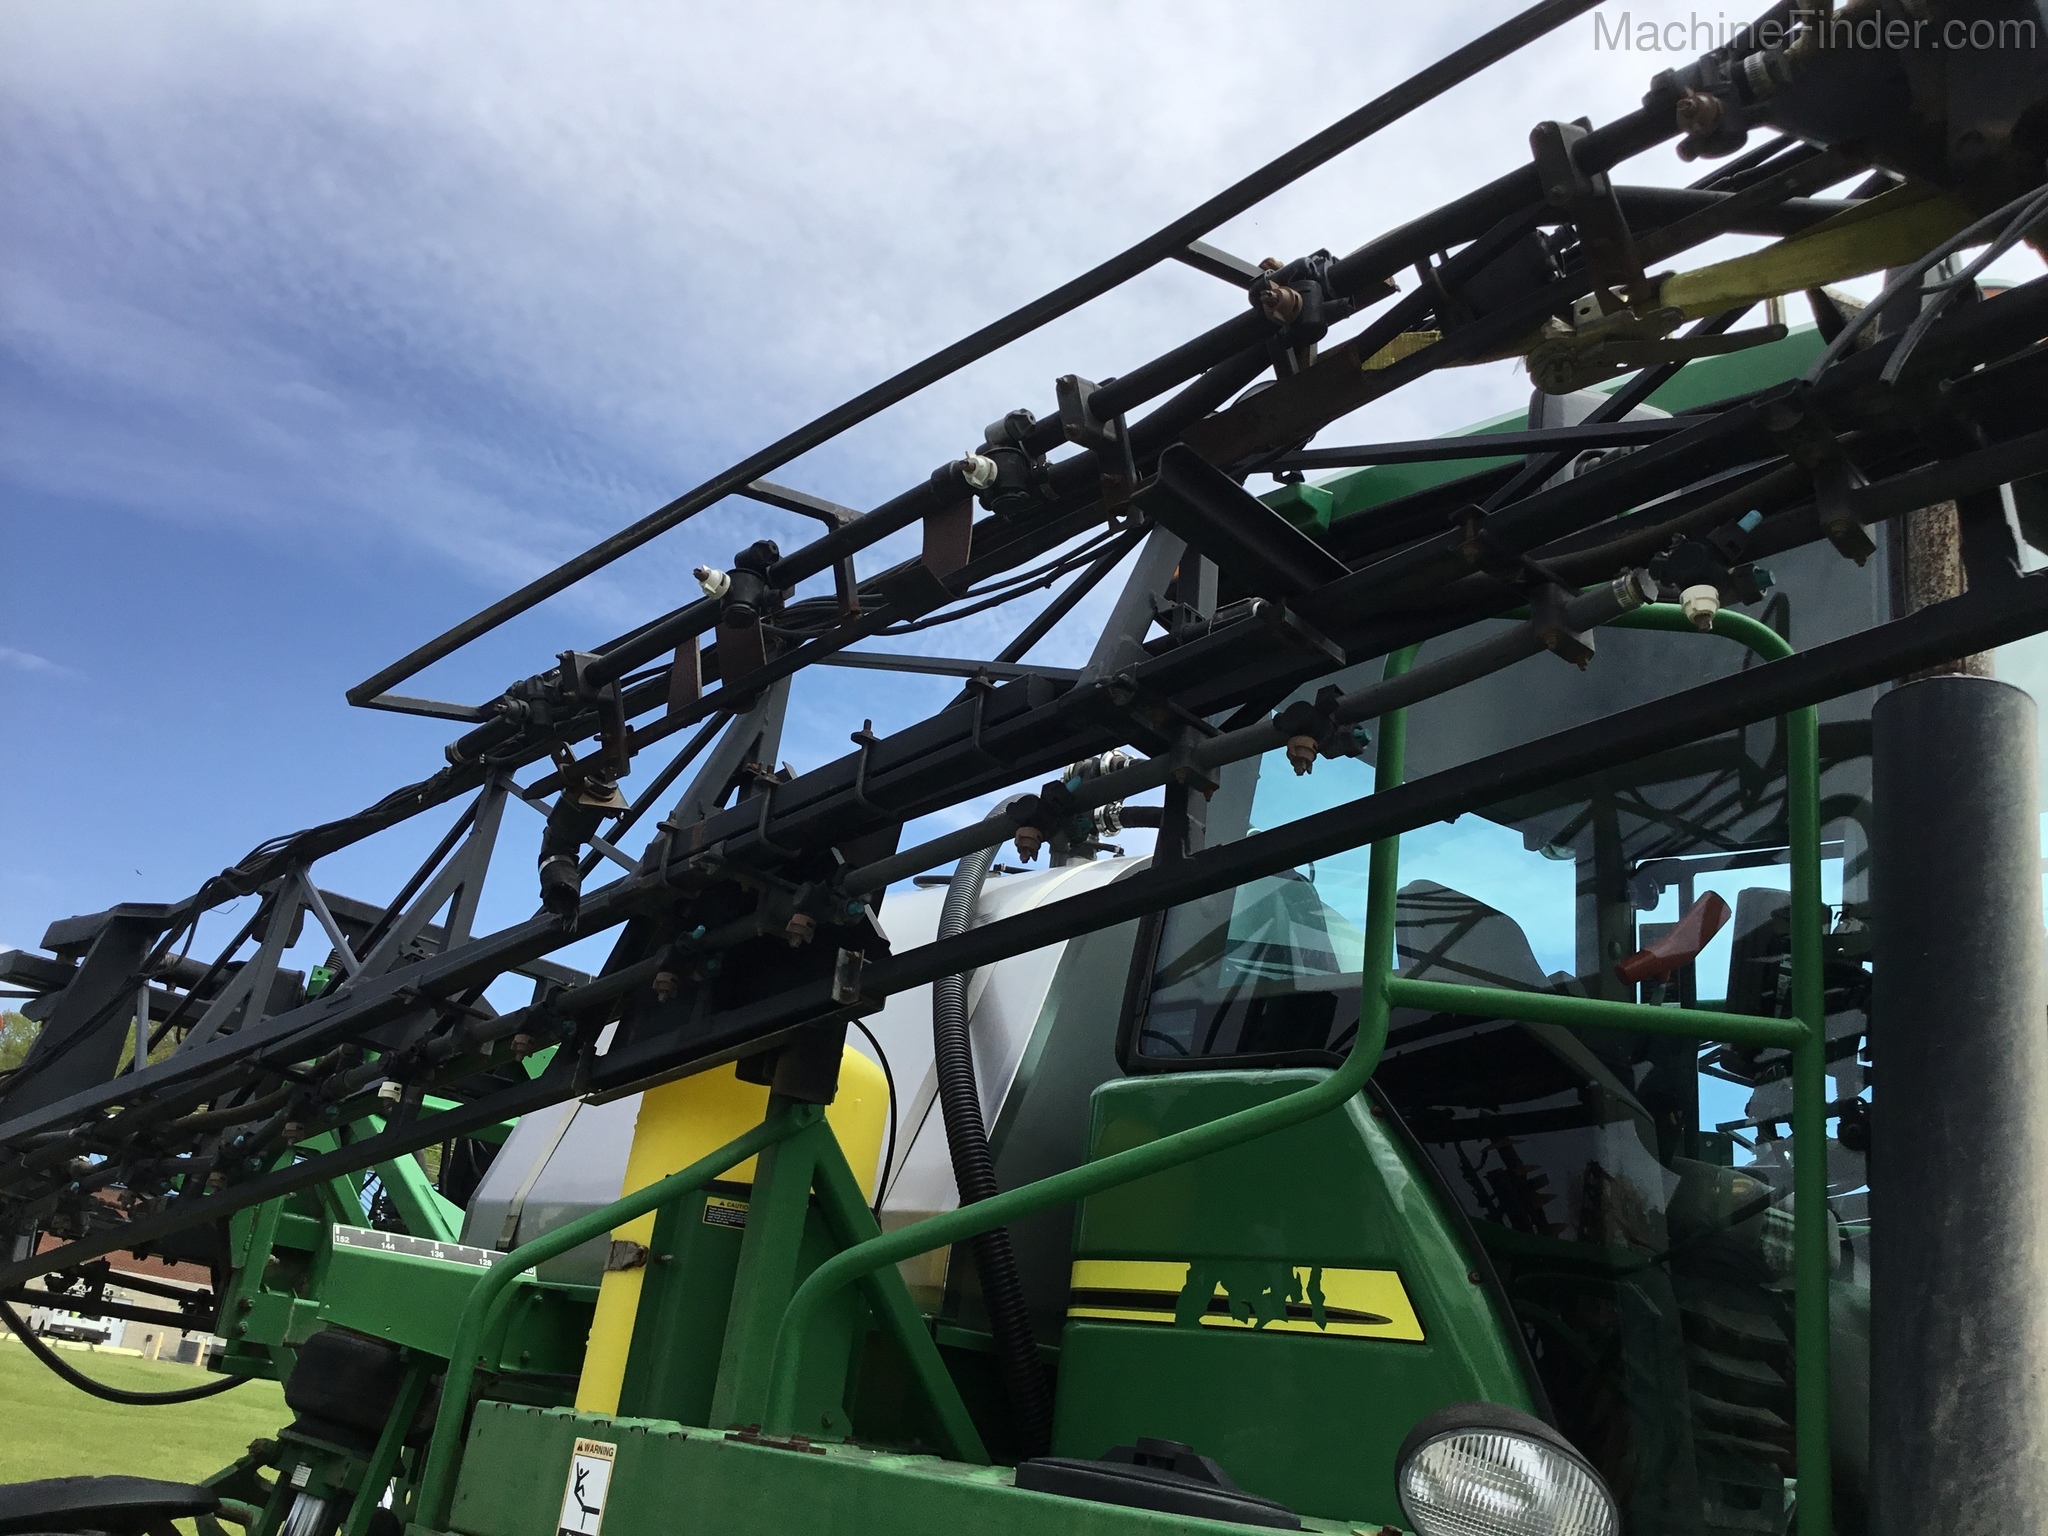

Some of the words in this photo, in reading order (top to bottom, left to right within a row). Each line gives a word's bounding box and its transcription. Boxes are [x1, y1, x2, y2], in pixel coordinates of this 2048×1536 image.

[726, 1202, 748, 1210] CAUTIO
[336, 1235, 350, 1244] 152
[381, 1242, 395, 1251] 144
[430, 1250, 444, 1259] 136
[478, 1258, 493, 1267] 128
[584, 1442, 614, 1457] WARNING
